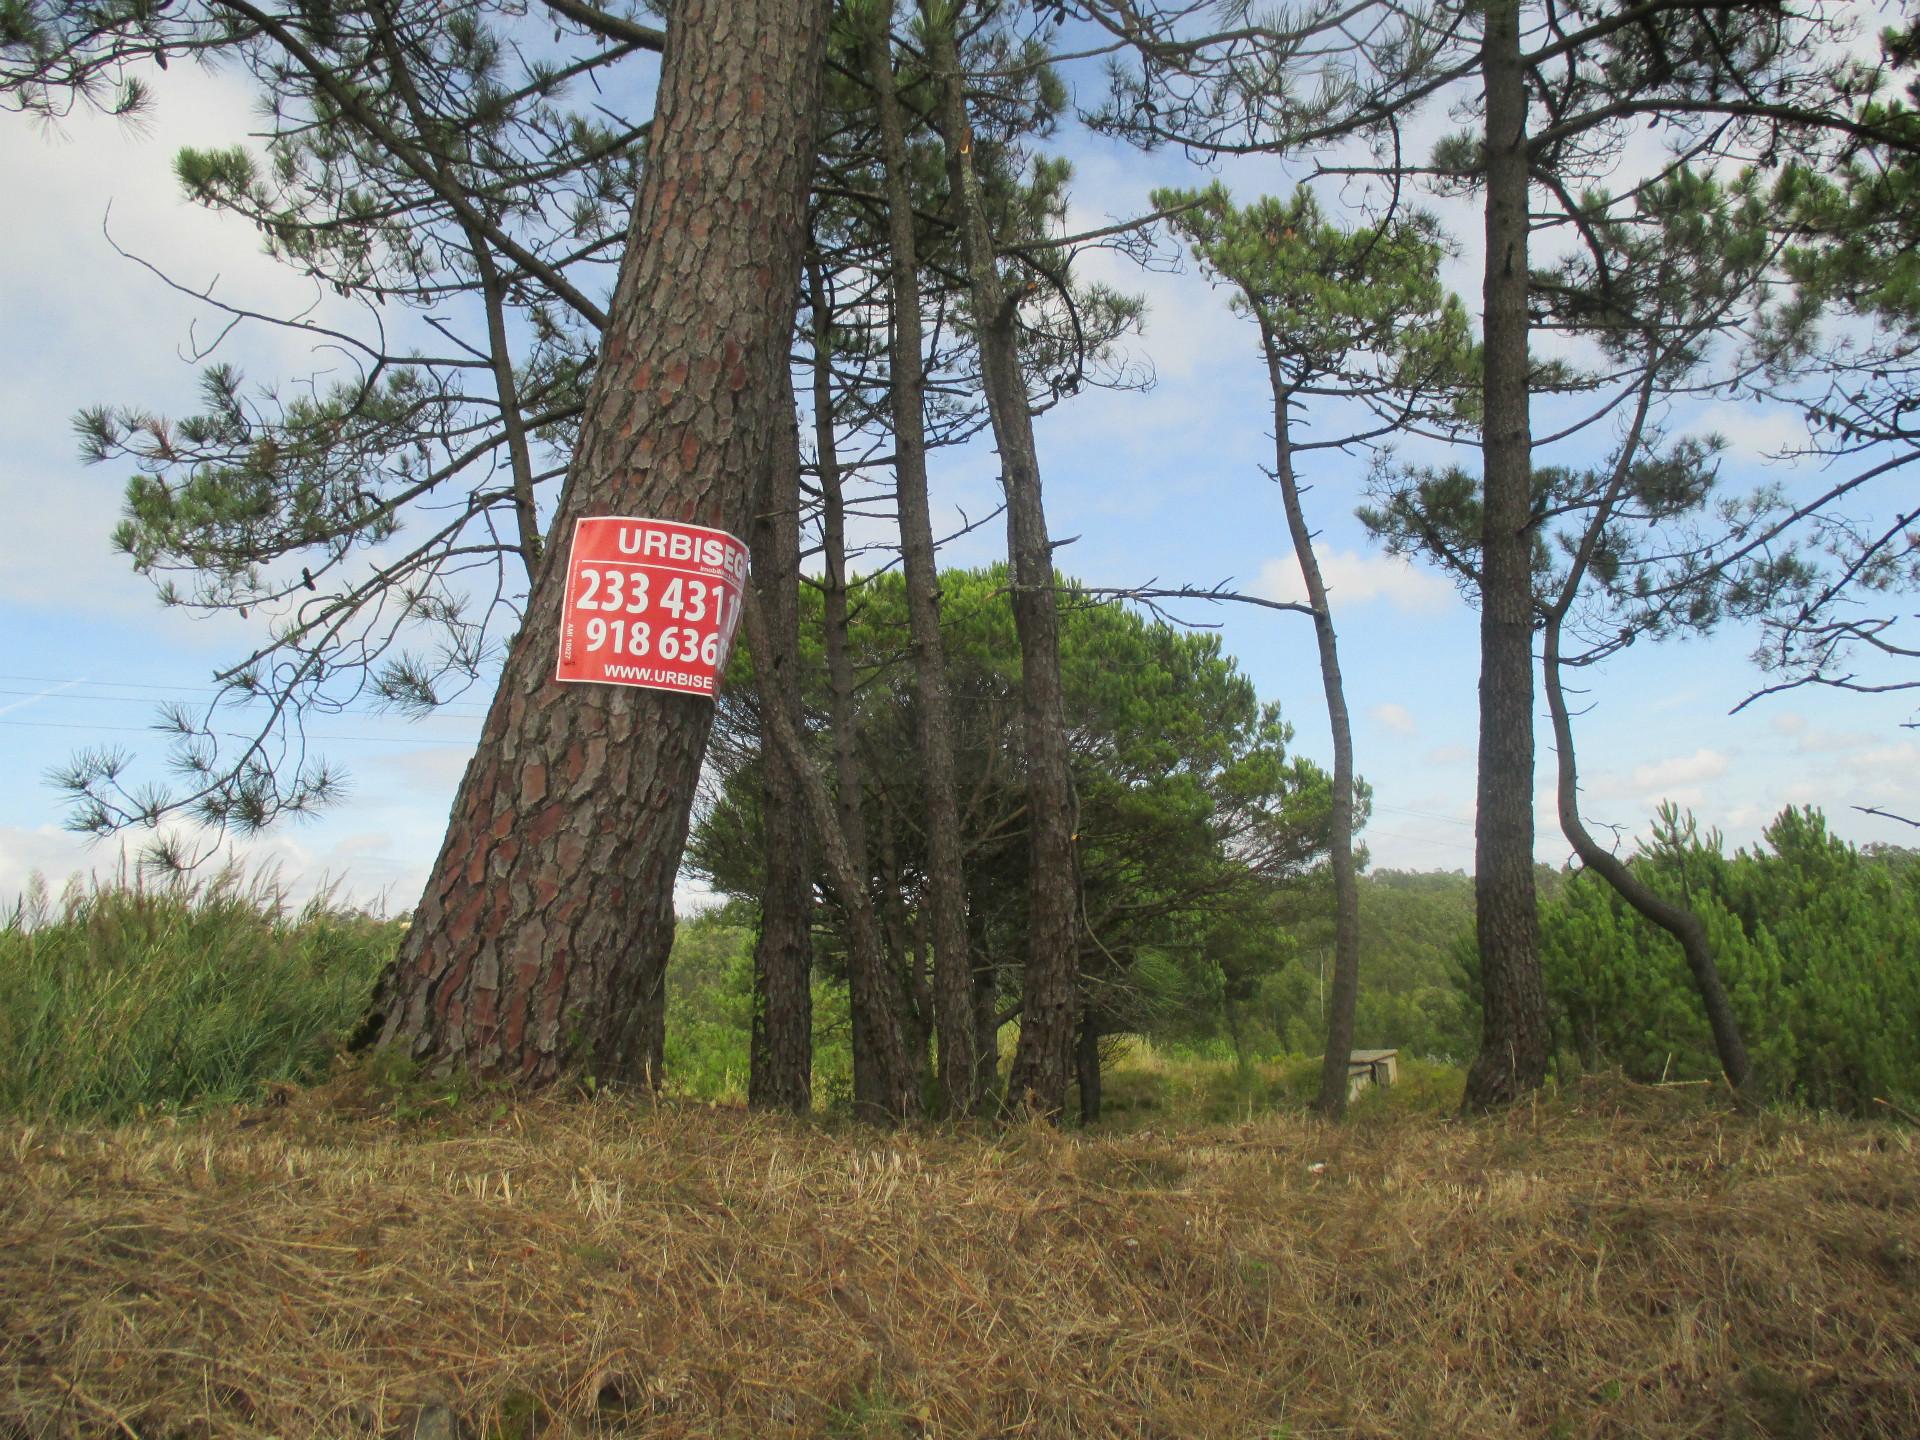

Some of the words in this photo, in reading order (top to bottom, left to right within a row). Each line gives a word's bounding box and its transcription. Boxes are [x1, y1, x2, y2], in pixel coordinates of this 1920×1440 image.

[576, 569, 650, 614] 233
[659, 577, 724, 625] 431
[586, 617, 651, 656] 918
[658, 626, 719, 666] 636
